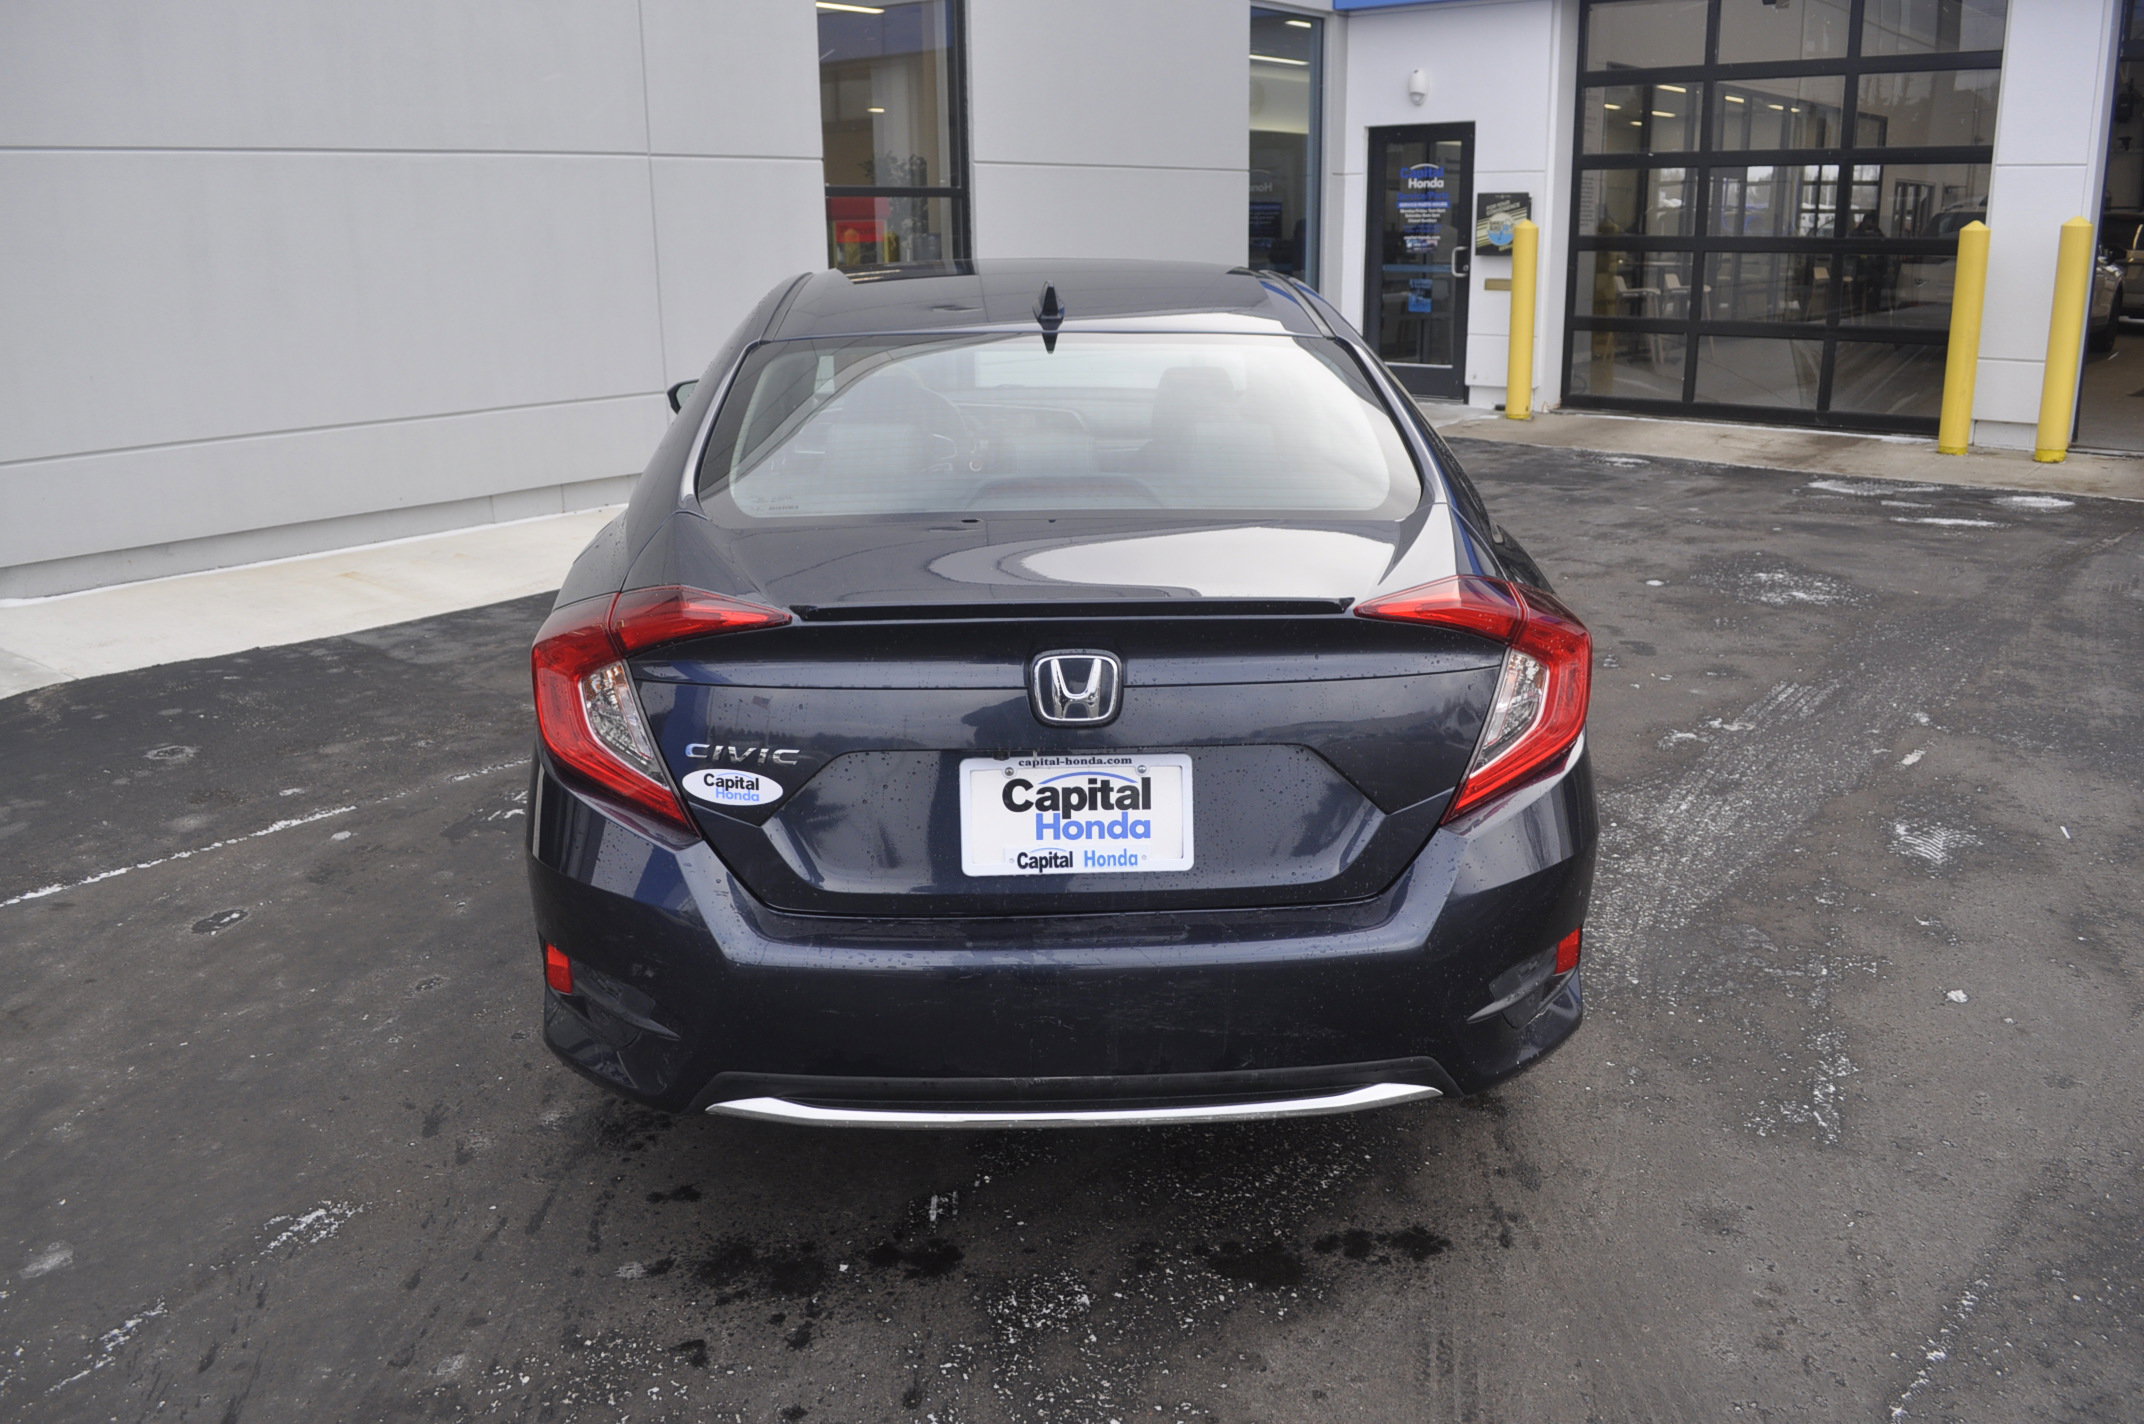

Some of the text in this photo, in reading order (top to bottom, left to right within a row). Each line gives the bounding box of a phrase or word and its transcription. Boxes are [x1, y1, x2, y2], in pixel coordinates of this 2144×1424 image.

[1400, 167, 1445, 180] Capital
[1408, 177, 1445, 189] Honda
[685, 743, 800, 765] CIVIC
[1018, 755, 1133, 768] capital-honda.com
[703, 773, 760, 791] Capital
[715, 787, 760, 802] Honda
[1002, 777, 1152, 820] Capital
[1035, 811, 1152, 841] Honda
[1017, 848, 1139, 873] Capital Honda
